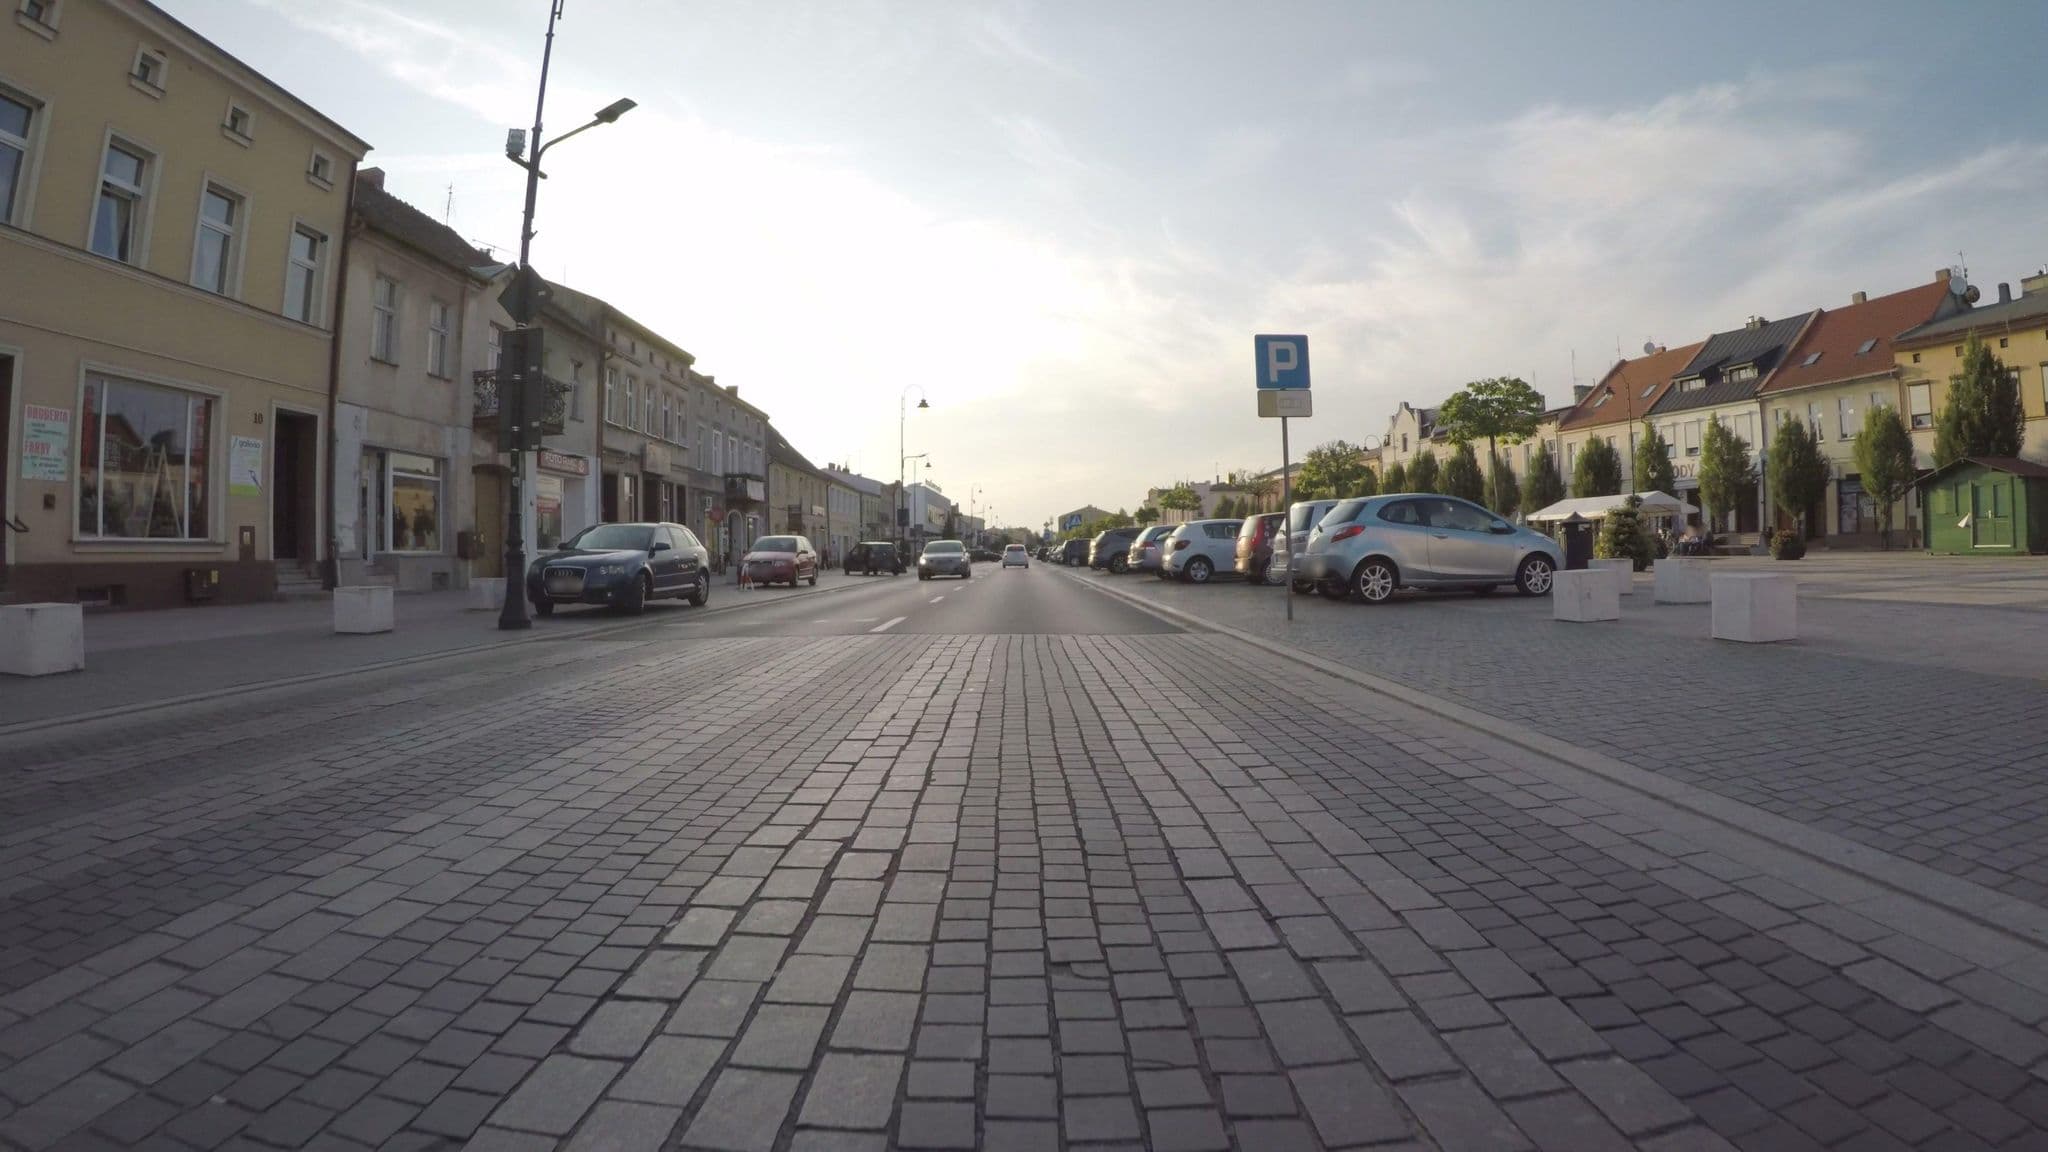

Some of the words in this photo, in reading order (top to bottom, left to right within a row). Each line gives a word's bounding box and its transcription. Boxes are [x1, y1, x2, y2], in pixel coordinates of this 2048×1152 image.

[1268, 340, 1298, 383] P
[253, 412, 264, 425] 10
[1672, 463, 1695, 479] ODY
